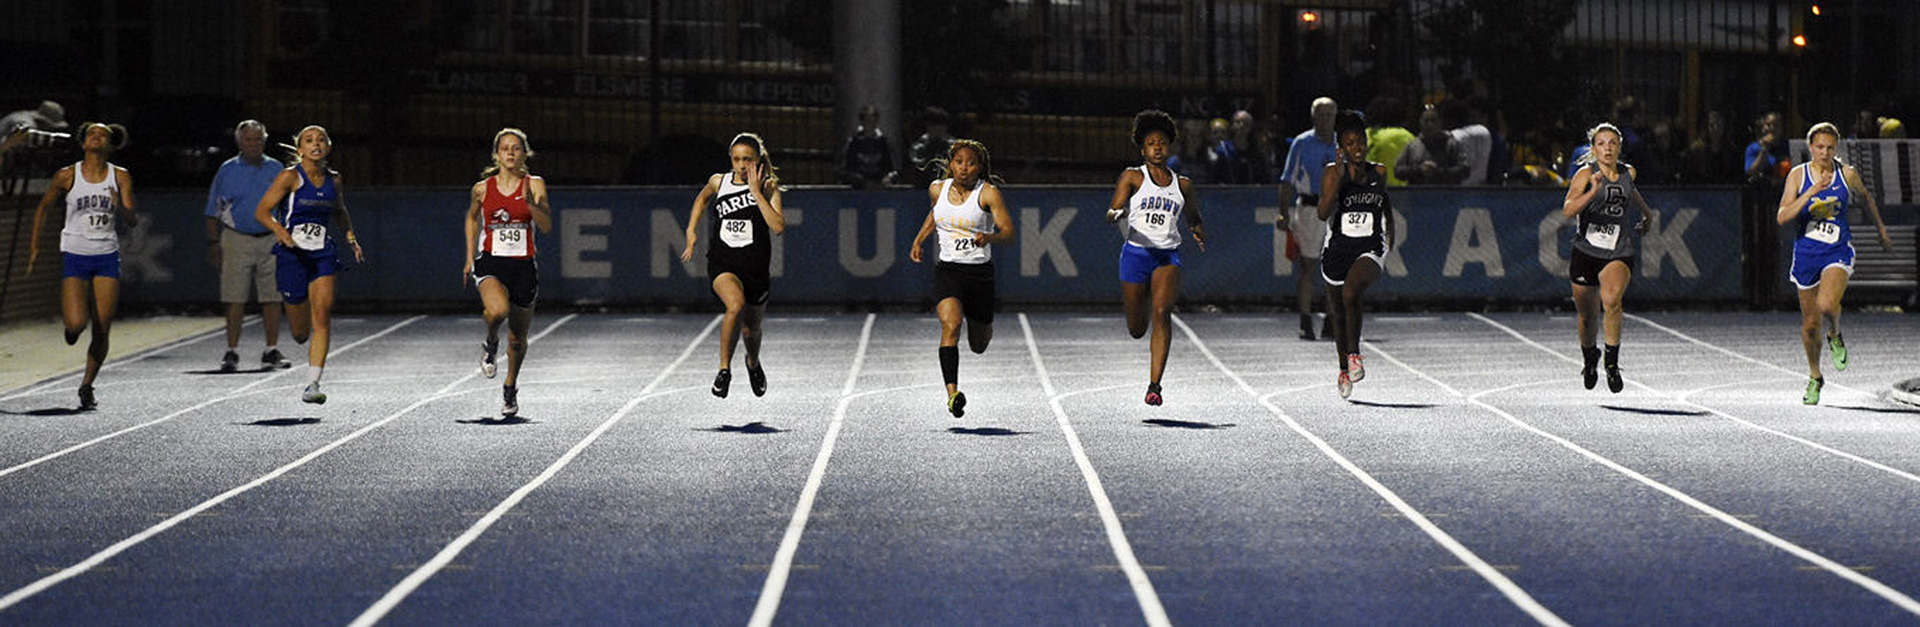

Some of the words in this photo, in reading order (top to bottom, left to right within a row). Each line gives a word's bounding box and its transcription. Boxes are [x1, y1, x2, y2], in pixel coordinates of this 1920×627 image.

[715, 192, 757, 218] PARIS
[1140, 196, 1180, 216] BROWN
[88, 214, 109, 226] 170
[1145, 212, 1166, 226] 166
[1348, 213, 1368, 225] 327
[301, 223, 322, 237] 473
[725, 221, 746, 233] 482
[499, 229, 521, 242] 549
